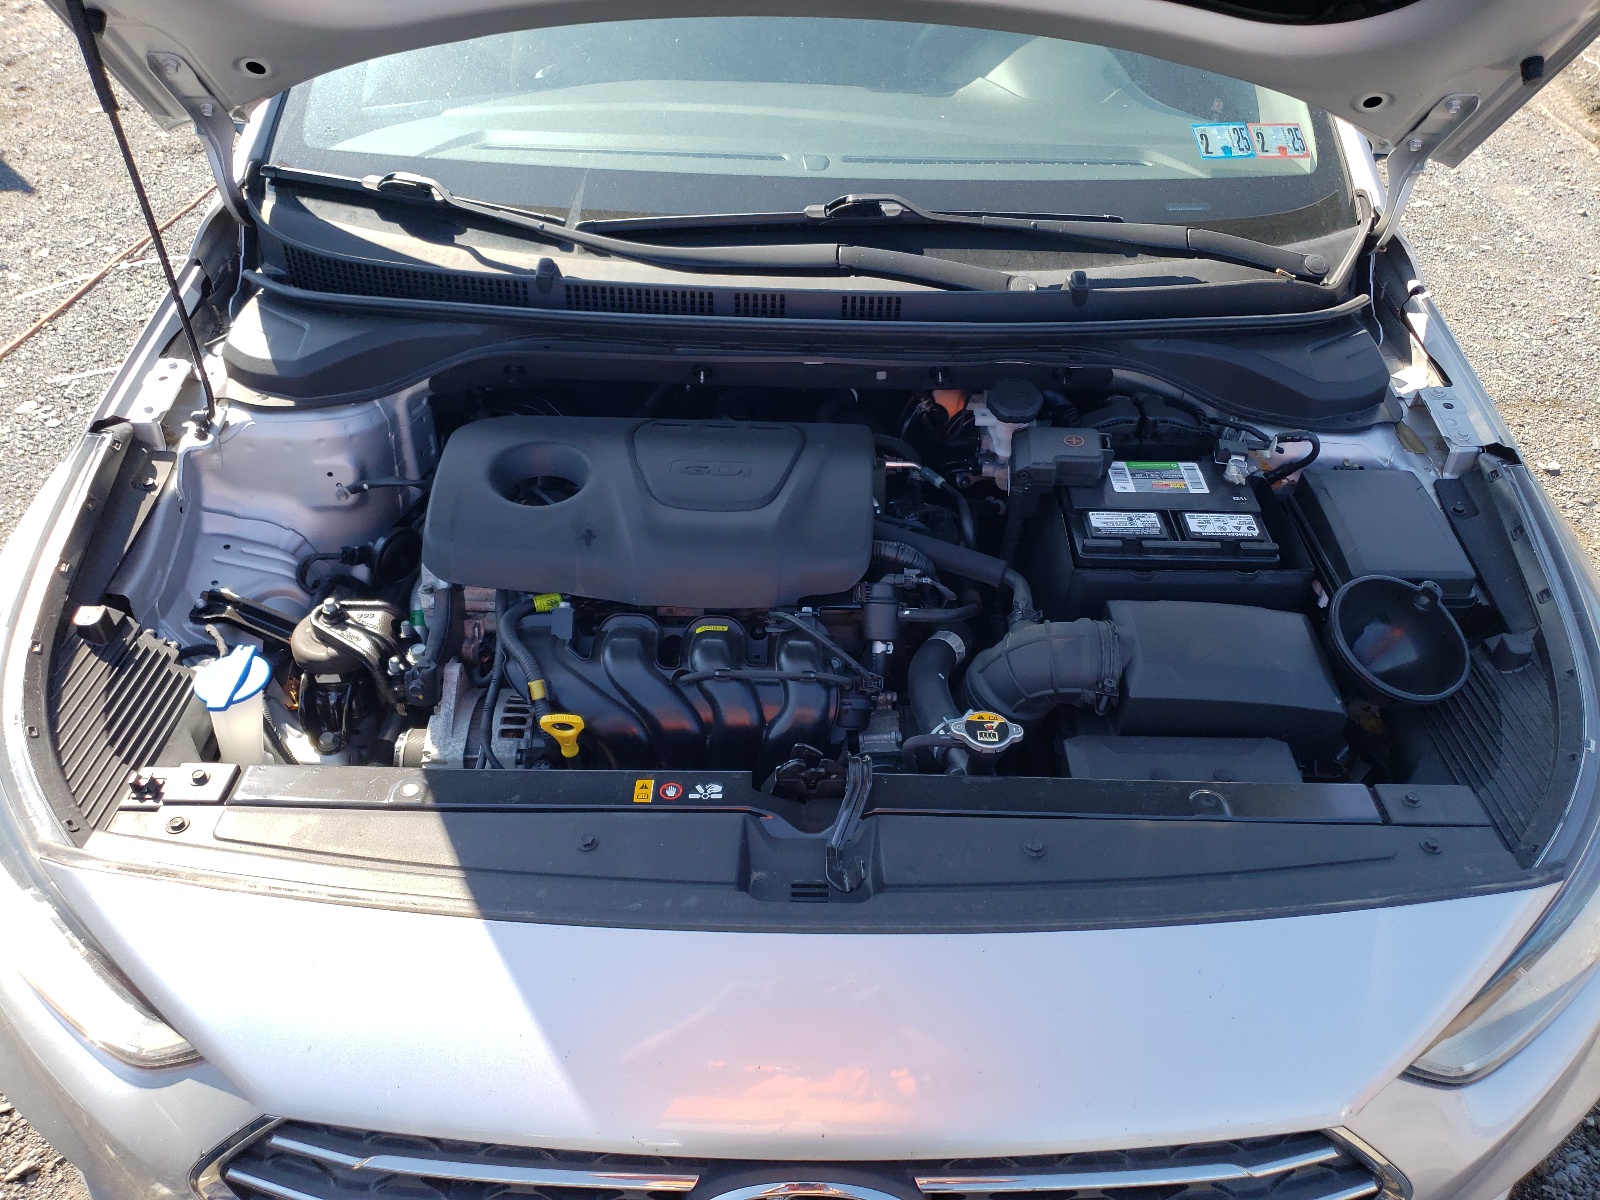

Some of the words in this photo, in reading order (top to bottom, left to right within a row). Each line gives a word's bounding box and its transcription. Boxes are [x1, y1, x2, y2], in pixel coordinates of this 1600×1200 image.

[1199, 133, 1213, 154] 2
[1232, 127, 1251, 152] 25
[1255, 131, 1269, 153] 2
[1286, 127, 1306, 152] 25
[680, 465, 752, 477] GDI
